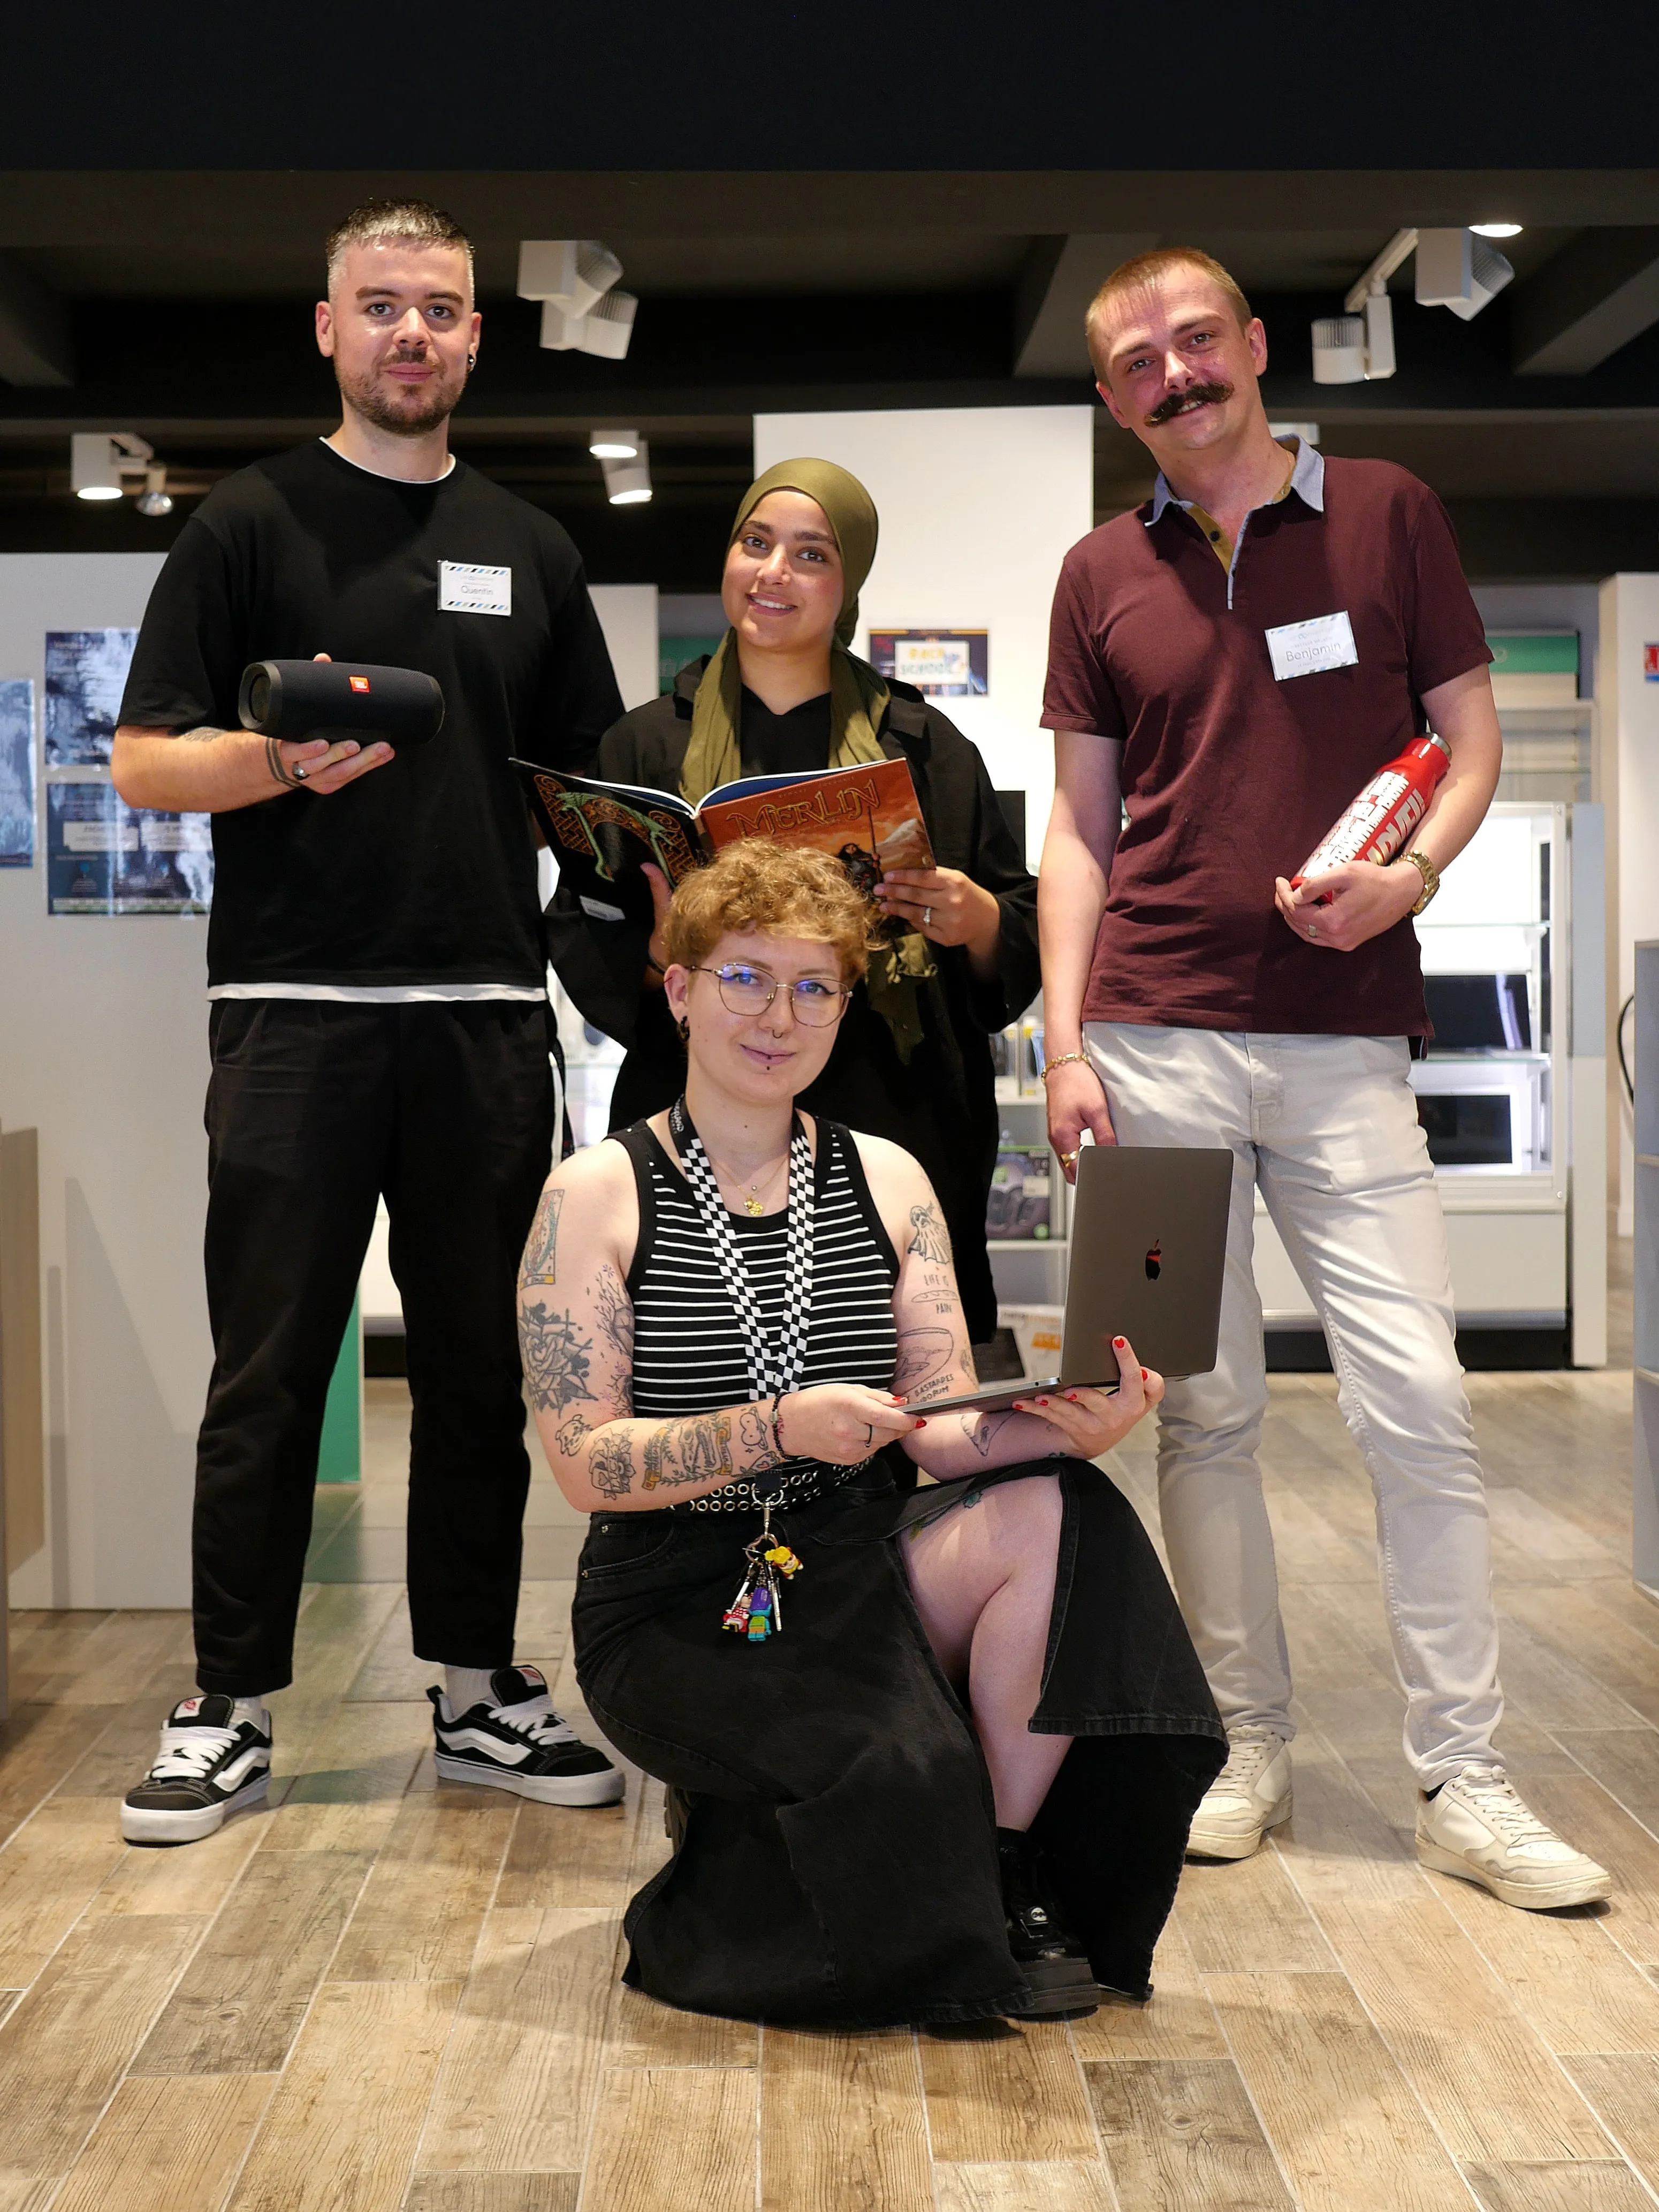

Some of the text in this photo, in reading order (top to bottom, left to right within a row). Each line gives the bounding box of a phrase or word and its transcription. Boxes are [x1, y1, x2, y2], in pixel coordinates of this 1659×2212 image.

[460, 585, 494, 596] Quentin
[1285, 642, 1341, 663] Benjamin
[725, 778, 880, 837] MERLIN
